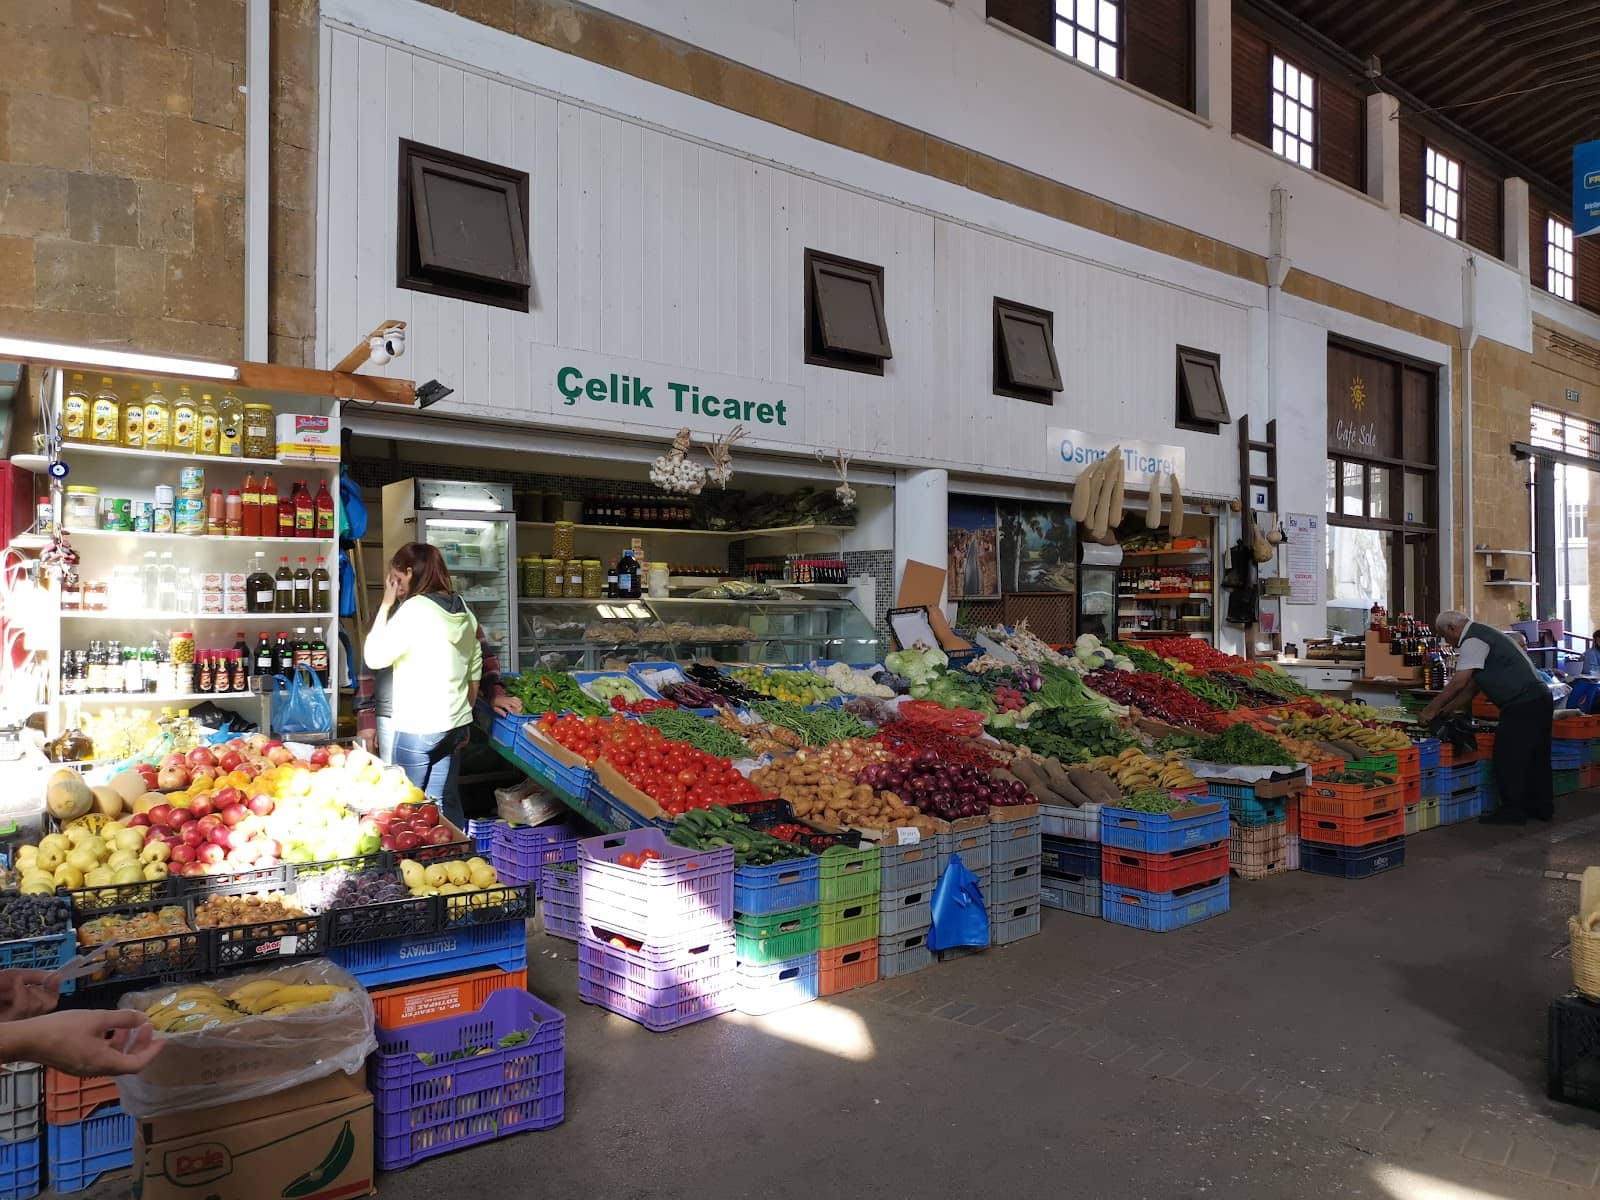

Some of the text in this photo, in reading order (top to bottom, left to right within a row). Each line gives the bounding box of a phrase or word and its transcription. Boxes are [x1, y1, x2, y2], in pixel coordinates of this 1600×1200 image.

[557, 366, 787, 426] Çelik Ticaret
[1359, 423, 1377, 447] Sole
[400, 940, 457, 959] FRUITWAYS
[176, 1150, 224, 1173] Dole
